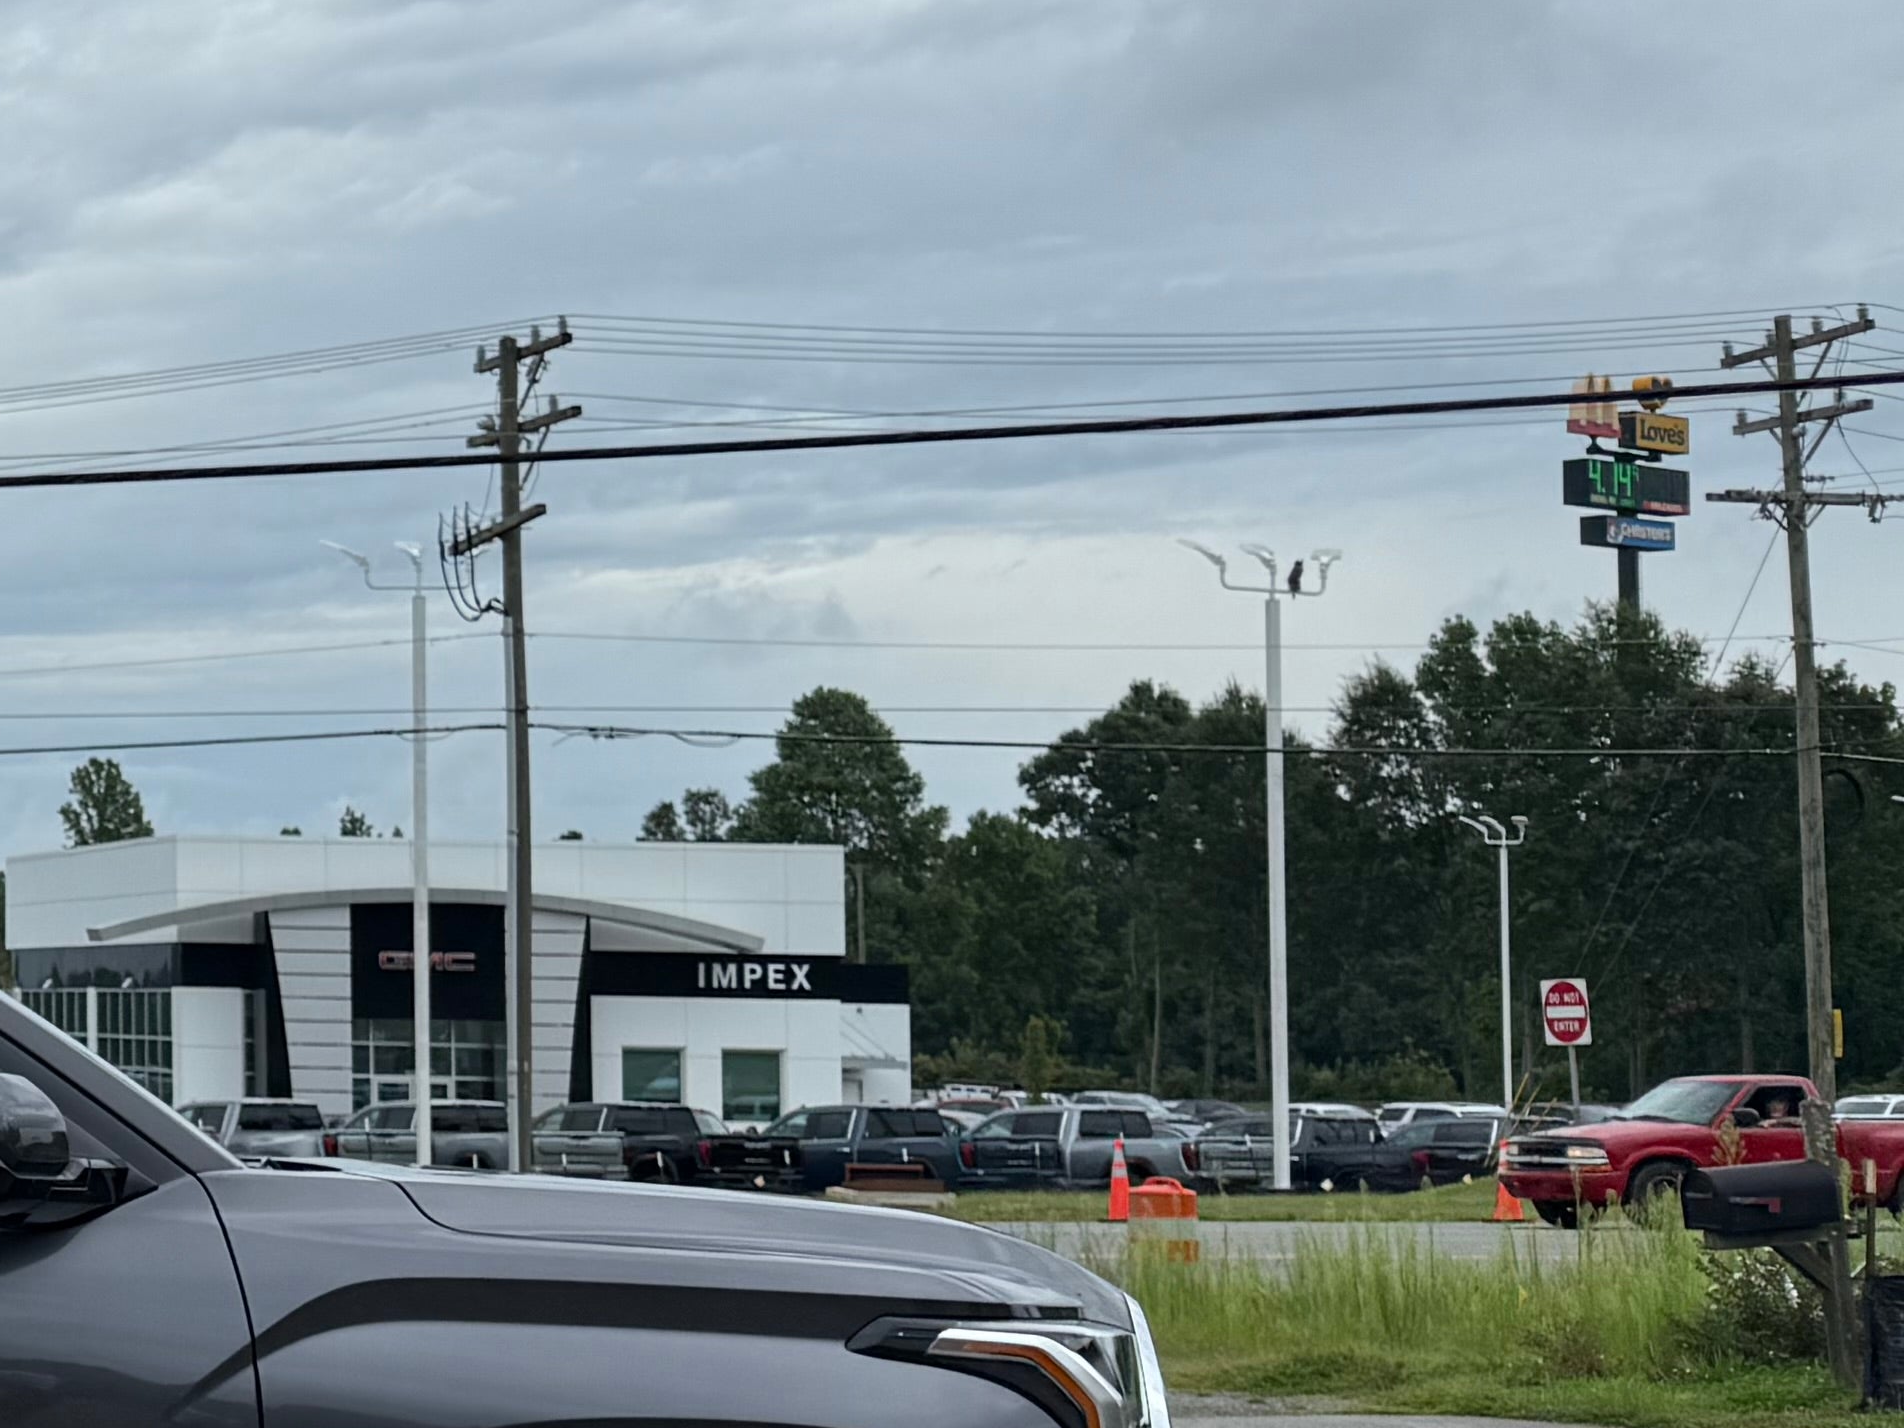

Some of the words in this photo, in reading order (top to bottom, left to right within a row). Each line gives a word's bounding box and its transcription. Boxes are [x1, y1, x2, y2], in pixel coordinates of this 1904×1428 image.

[1639, 419, 1685, 446] Love's
[697, 962, 812, 990] IMPEX
[1549, 992, 1560, 1004] DO
[1563, 992, 1580, 1003] NOT
[1554, 1020, 1580, 1032] ENTER
